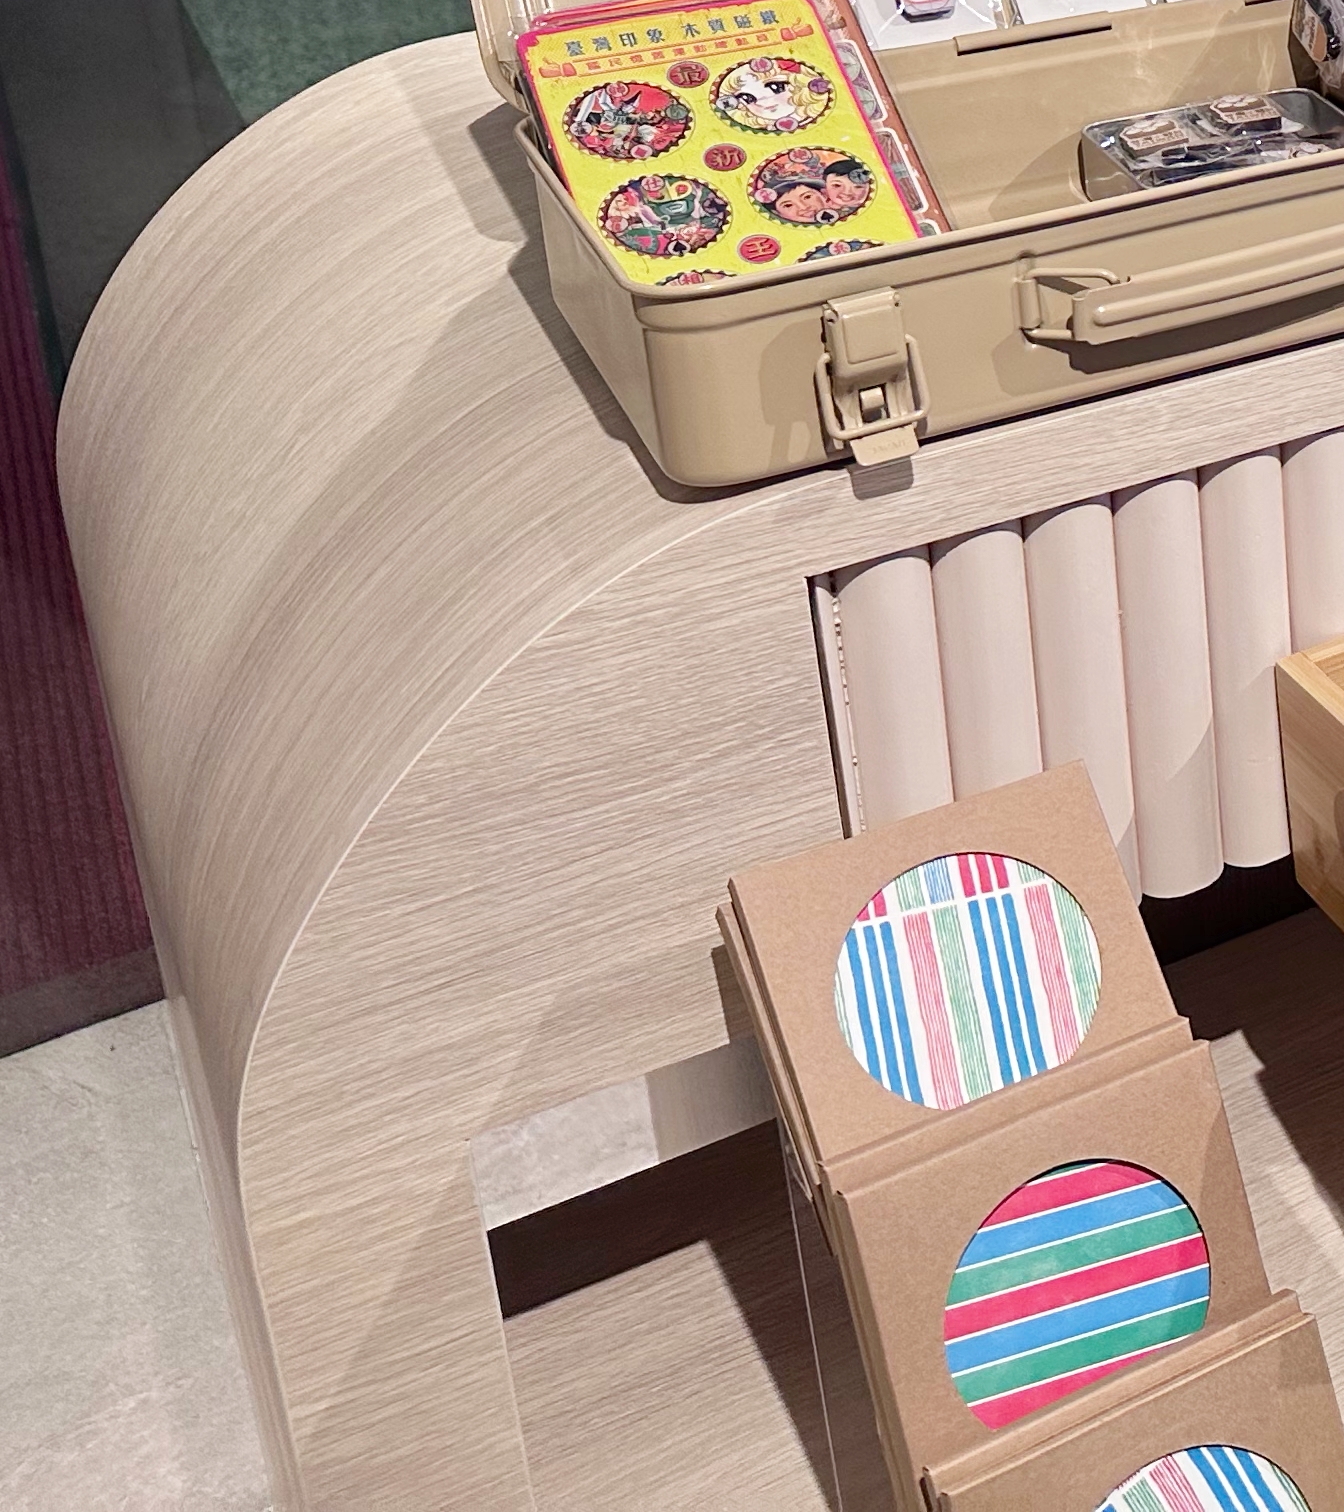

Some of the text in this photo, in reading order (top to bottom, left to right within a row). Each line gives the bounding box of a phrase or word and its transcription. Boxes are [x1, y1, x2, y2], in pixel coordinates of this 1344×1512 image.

[563, 27, 666, 57] 臺灣印象
[745, 238, 778, 259] 王
